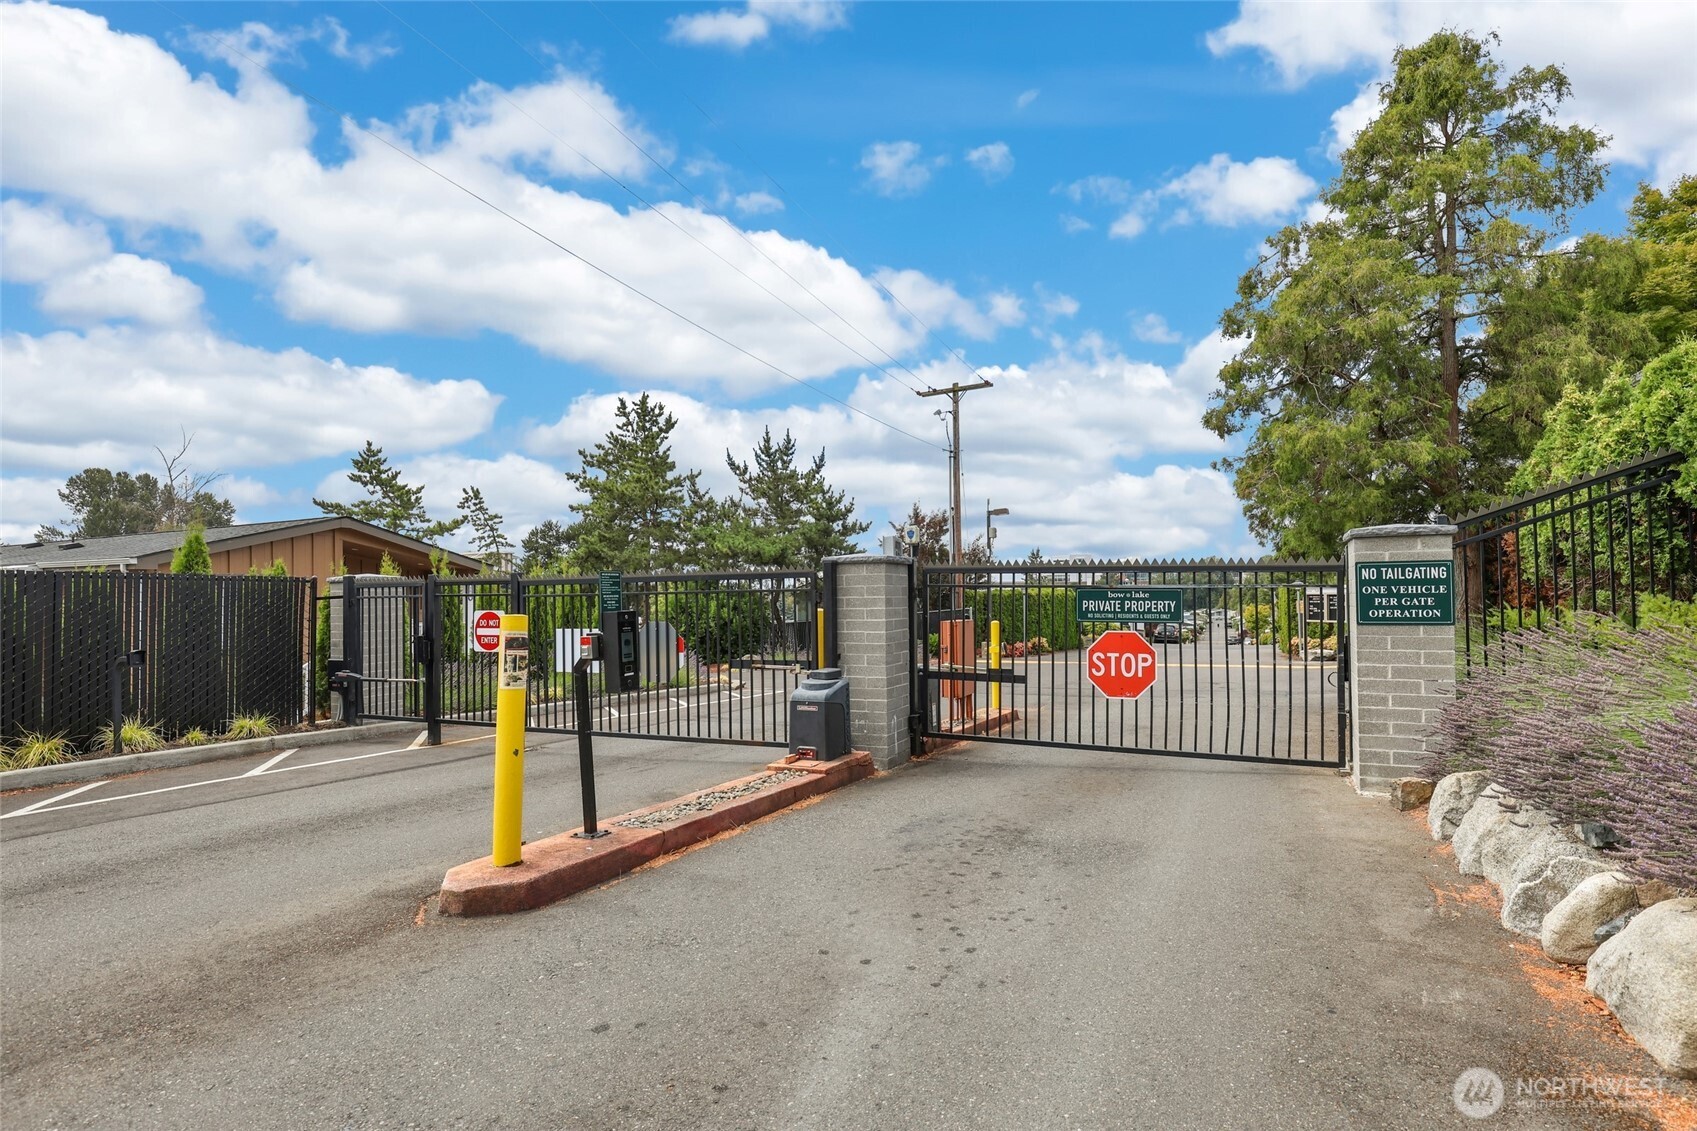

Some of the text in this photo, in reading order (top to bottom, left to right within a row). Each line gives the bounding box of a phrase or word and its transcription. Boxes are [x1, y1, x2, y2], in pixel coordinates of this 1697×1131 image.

[1361, 566, 1447, 580] NO TAILGATING
[1108, 590, 1150, 598] bow lake
[1362, 585, 1448, 594] ONE VEHICLE
[1082, 600, 1176, 612] PRIVATE PROPERTY
[1374, 597, 1435, 606] PER GATE
[1368, 609, 1441, 618] OPERATION
[479, 619, 500, 628] DO NOT
[480, 636, 498, 644] ENTER
[1091, 651, 1153, 678] STOP
